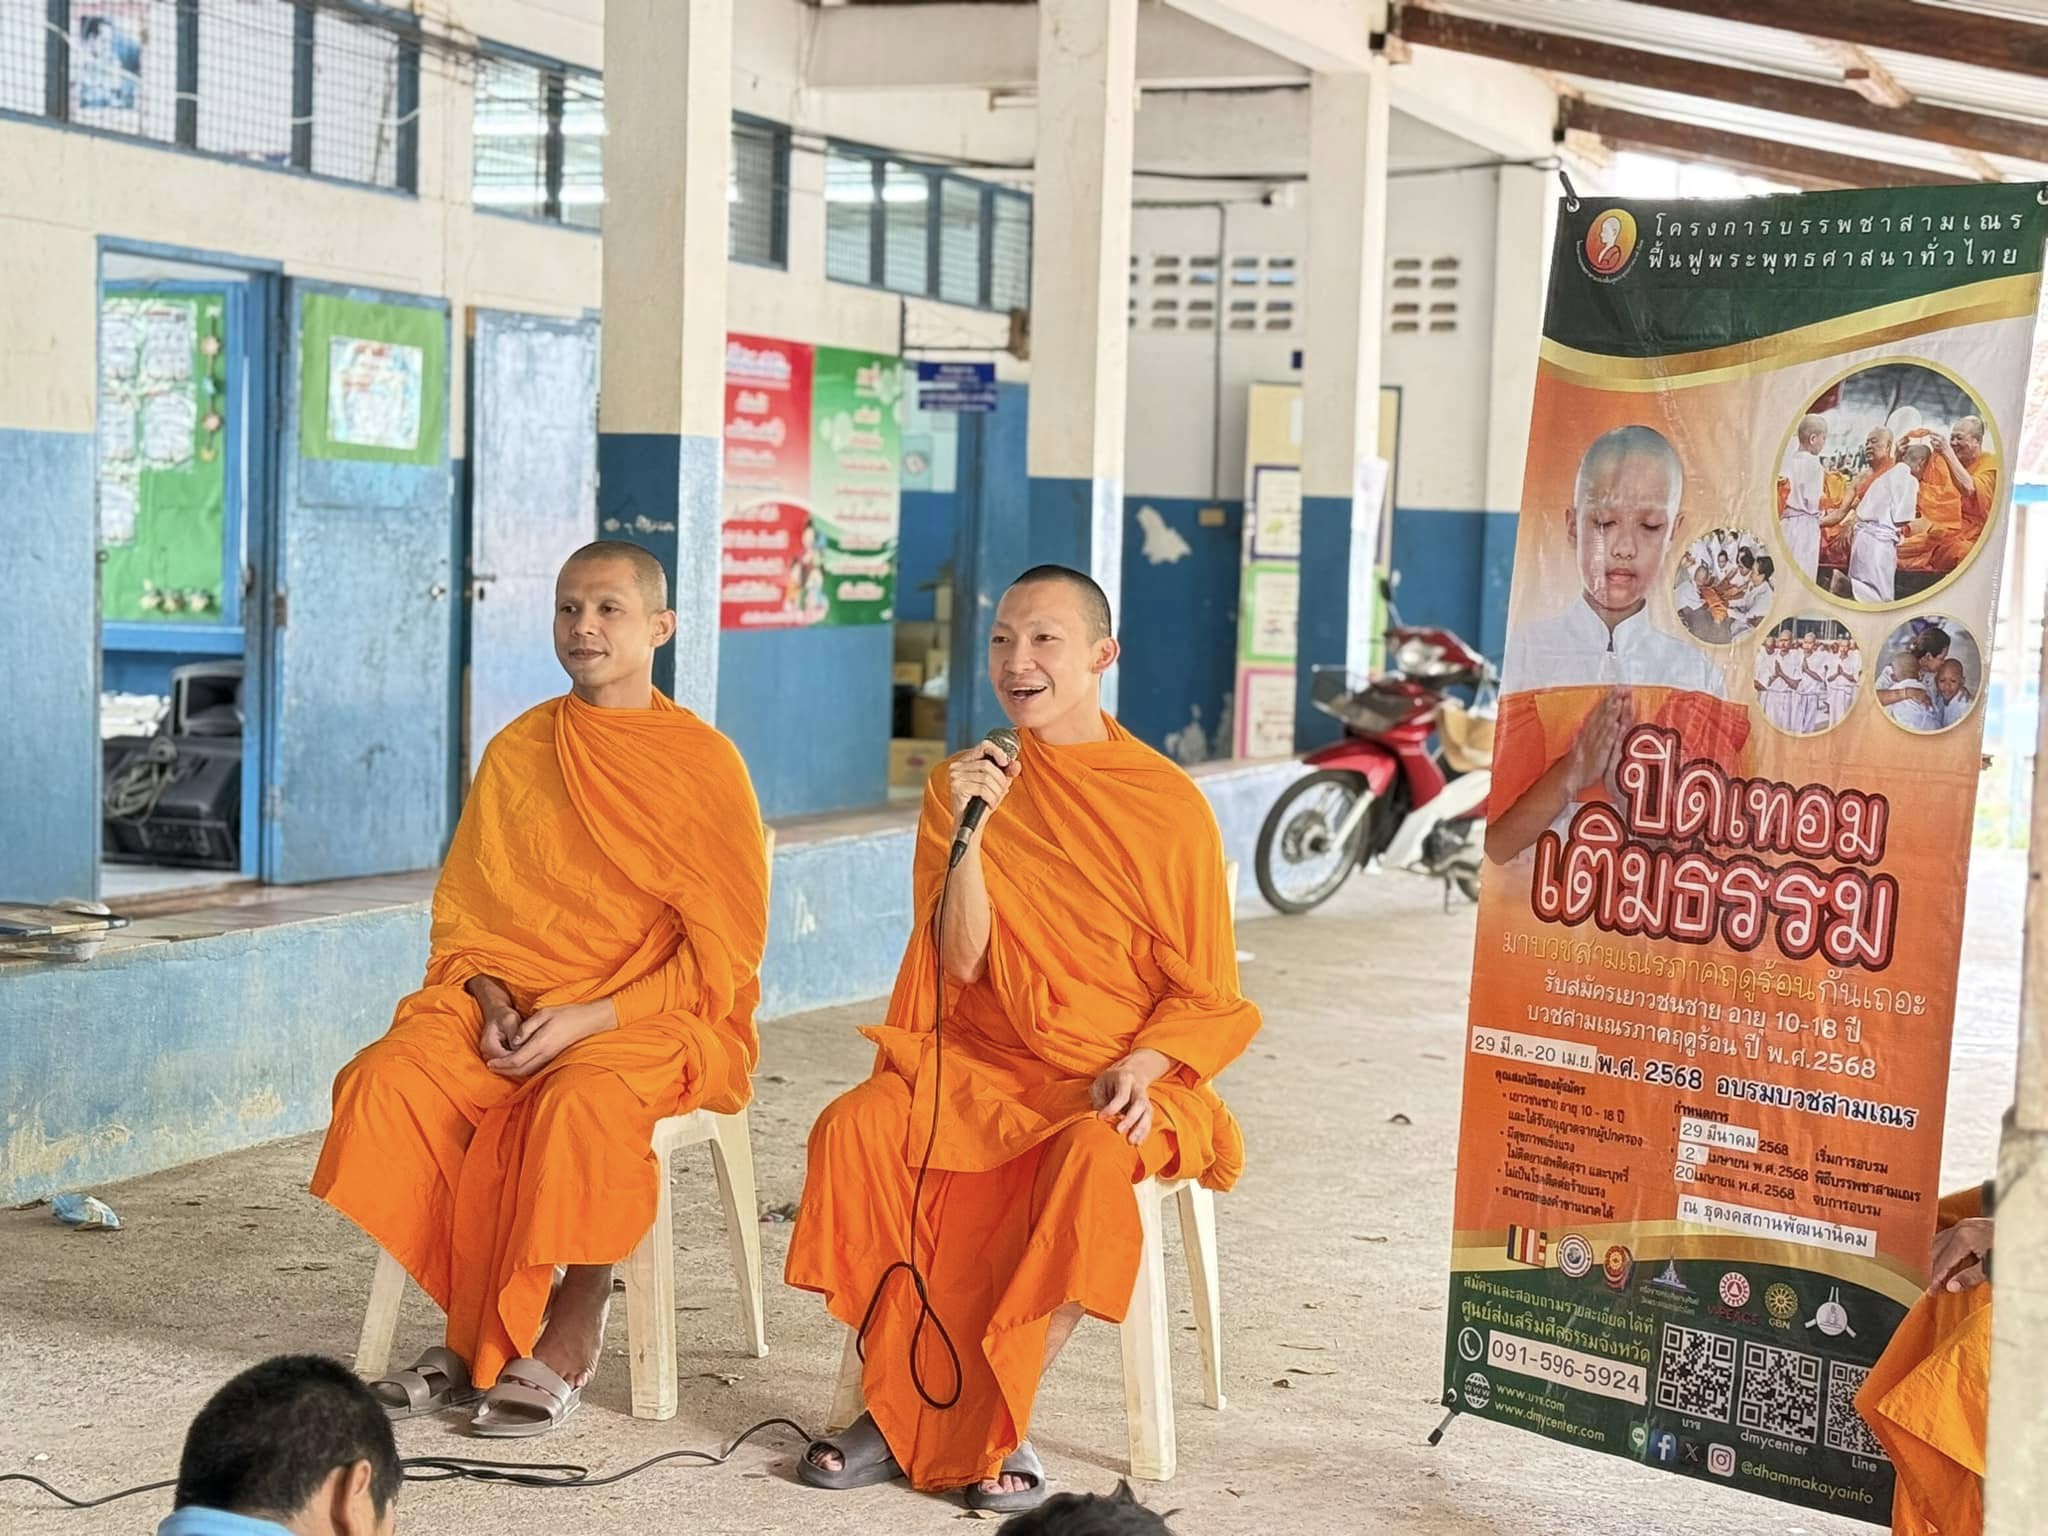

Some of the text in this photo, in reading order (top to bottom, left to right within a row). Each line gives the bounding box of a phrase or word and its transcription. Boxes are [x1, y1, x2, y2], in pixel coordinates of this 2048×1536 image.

[1655, 212, 2023, 237] โครงการบรรพชาสามเณร
[1649, 237, 2018, 275] ฟื้นฟูพระพุทธศาสนาทั่วไทย
[1621, 730, 1881, 858] ปิดเทอม
[1537, 810, 1891, 962] เติมธรรม
[1544, 968, 1861, 1043] รับสมัครเยาวชนชาย อายุ 10-18 ปี
[1527, 1004, 1737, 1060] บวชสามเณรภาคฤดูร้อน
[1745, 1032, 1760, 1059] ปี
[1474, 1035, 1495, 1051] 29
[1562, 1051, 1593, 1069] เม.ย.
[1599, 1055, 1638, 1079] พ.ศ.
[1645, 1062, 1703, 1090] 2568
[1717, 1077, 1917, 1129] อบรมบวชสามเณร
[1581, 1105, 1592, 1117] 10
[1603, 1108, 1614, 1121] 18
[1682, 1122, 1789, 1156] 29 มีนาคม 2568
[1685, 1147, 1695, 1160] 2
[1815, 1144, 1889, 1175] เริ่มการอบรม
[1815, 1169, 1922, 1202] พิธีบรรพชาสามเณร
[1683, 1200, 1868, 1248] ณ ธุดงคสถานพัฒนานิคม
[1813, 1194, 1881, 1217] จบการอบรม
[1492, 1339, 1641, 1395] 091-596-5924
[1494, 1400, 1605, 1442] www.dmycenter.com
[1740, 1429, 1809, 1457] dmycenter
[1741, 1461, 1874, 1505] @dhammakayainfo
[1851, 1455, 1877, 1473] Line
